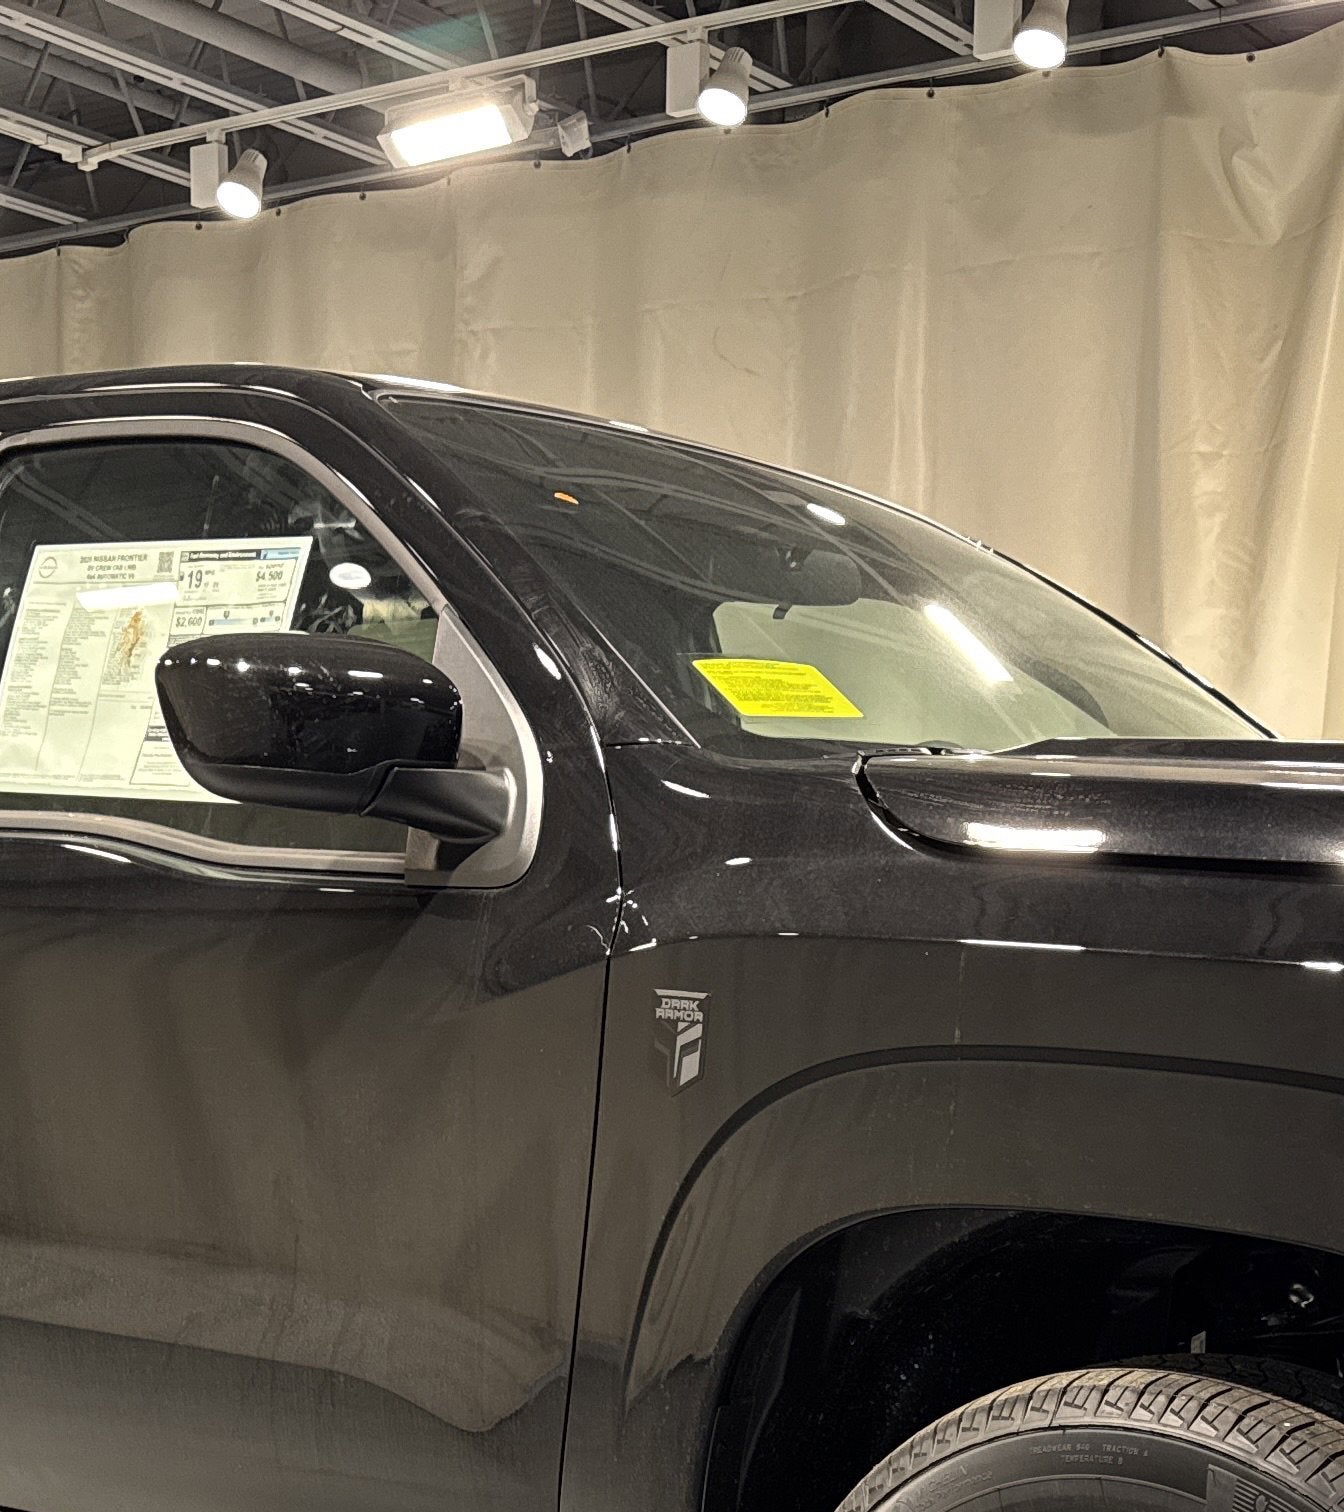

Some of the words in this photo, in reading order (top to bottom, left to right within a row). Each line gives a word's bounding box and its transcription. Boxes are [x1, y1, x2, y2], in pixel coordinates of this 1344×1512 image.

[117, 553, 148, 563] FRONTIER
[188, 569, 203, 589] 19
[660, 997, 701, 1012] DARK
[655, 1007, 704, 1022] ARMOR
